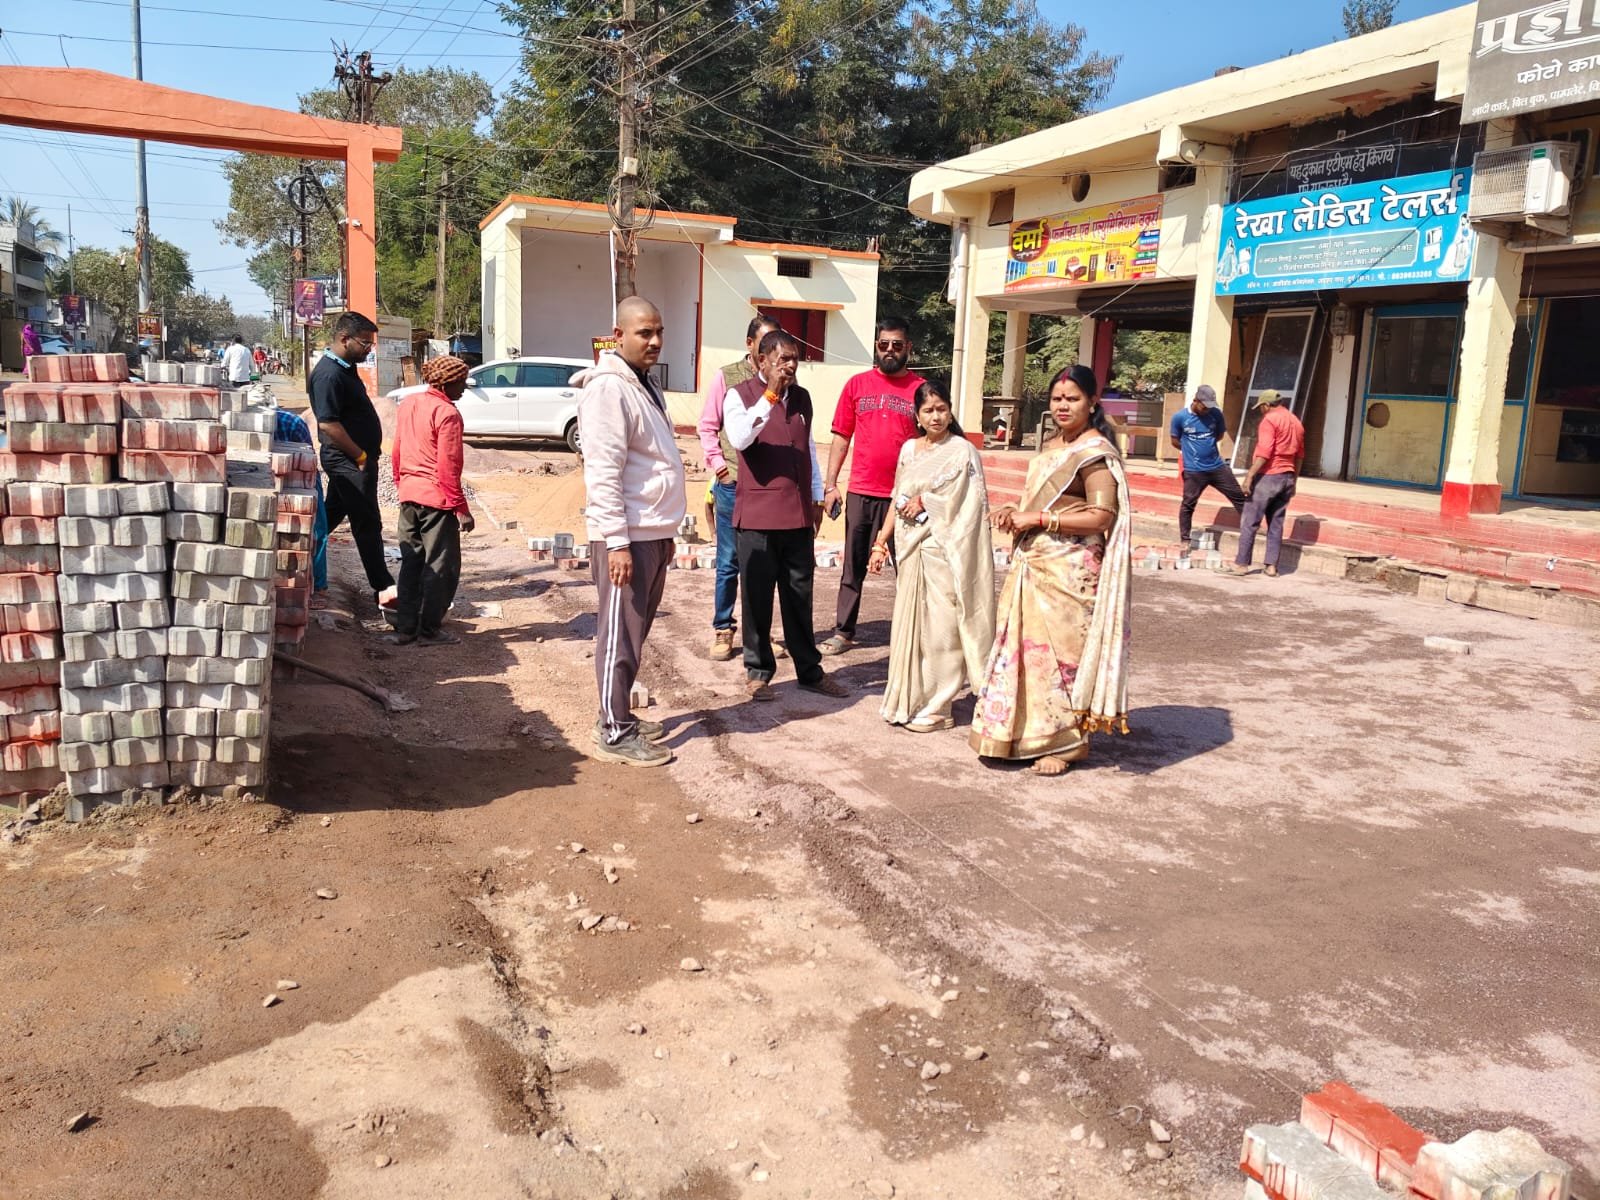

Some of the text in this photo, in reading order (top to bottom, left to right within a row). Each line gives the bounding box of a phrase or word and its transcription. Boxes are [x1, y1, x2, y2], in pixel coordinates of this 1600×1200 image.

[1517, 59, 1562, 84] फोटो
[1290, 164, 1302, 180] यह
[1302, 160, 1326, 184] दुकान
[1326, 152, 1353, 176] एटीएम
[1353, 150, 1366, 172] हेतु
[1235, 173, 1464, 239] रेखा लेडिस टेलर्स
[1012, 218, 1048, 252] वर्मा
[1051, 220, 1078, 240] फर्नीचर
